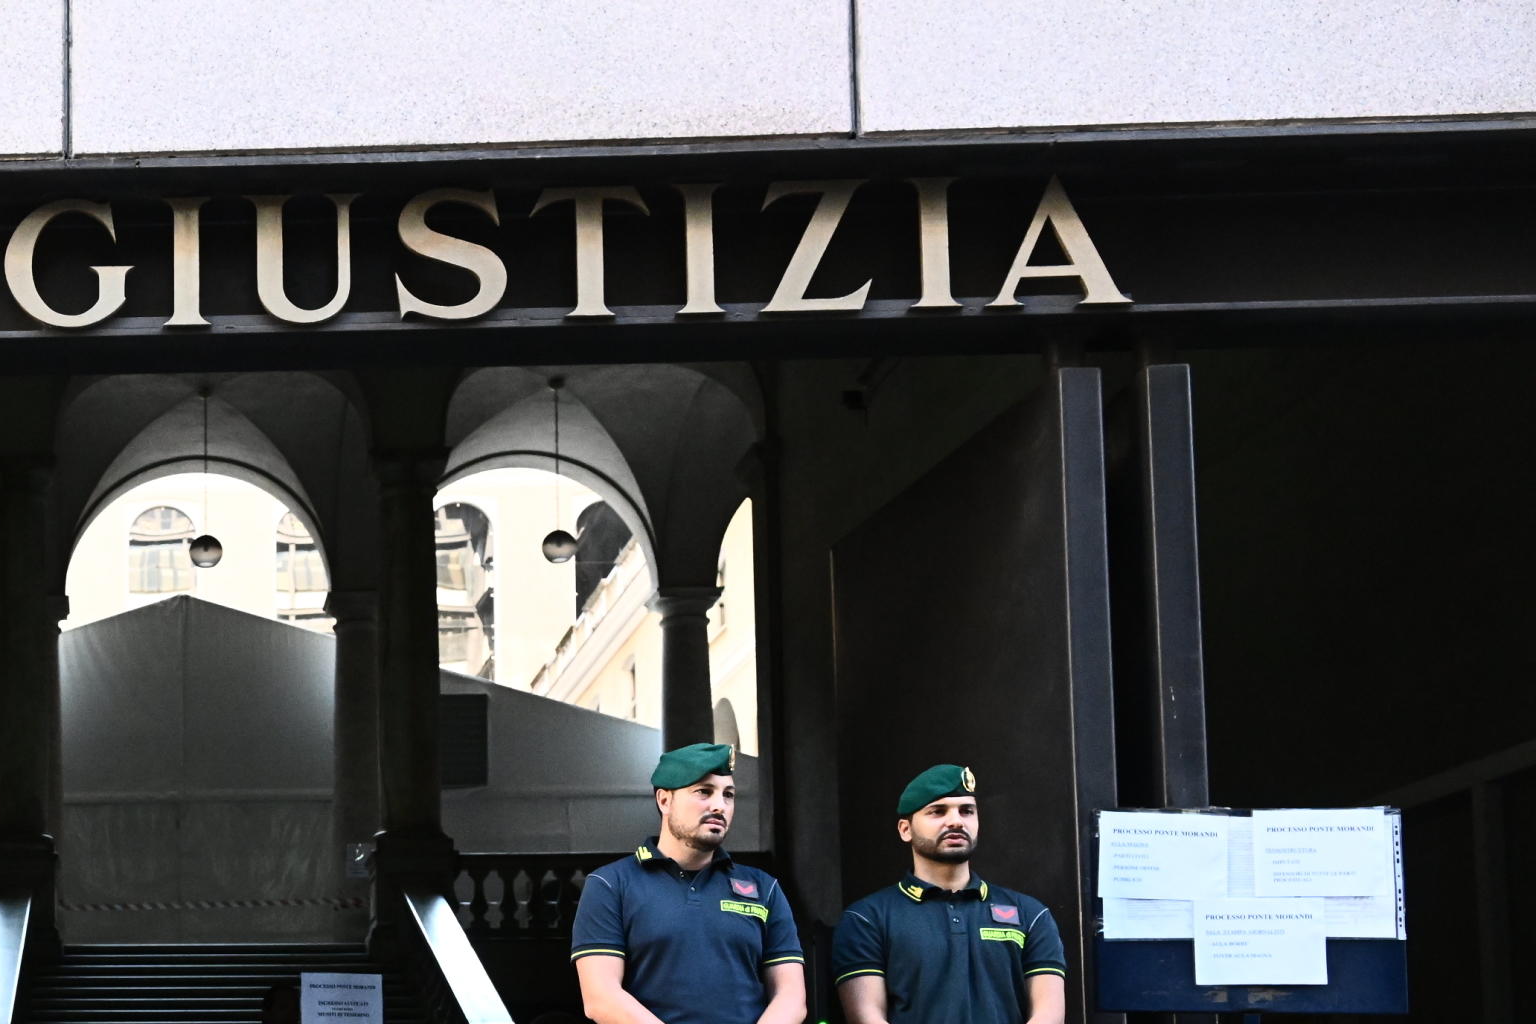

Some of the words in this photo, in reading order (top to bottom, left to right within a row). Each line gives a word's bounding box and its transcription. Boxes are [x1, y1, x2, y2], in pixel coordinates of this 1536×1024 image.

[4, 175, 1133, 329] GIUSTIZIA
[1113, 828, 1153, 836] PROCESSO
[1154, 829, 1178, 837] PONTE
[1181, 830, 1218, 838] MORANDI
[1266, 825, 1308, 833] PROCESSO
[1309, 825, 1334, 833] PONTE
